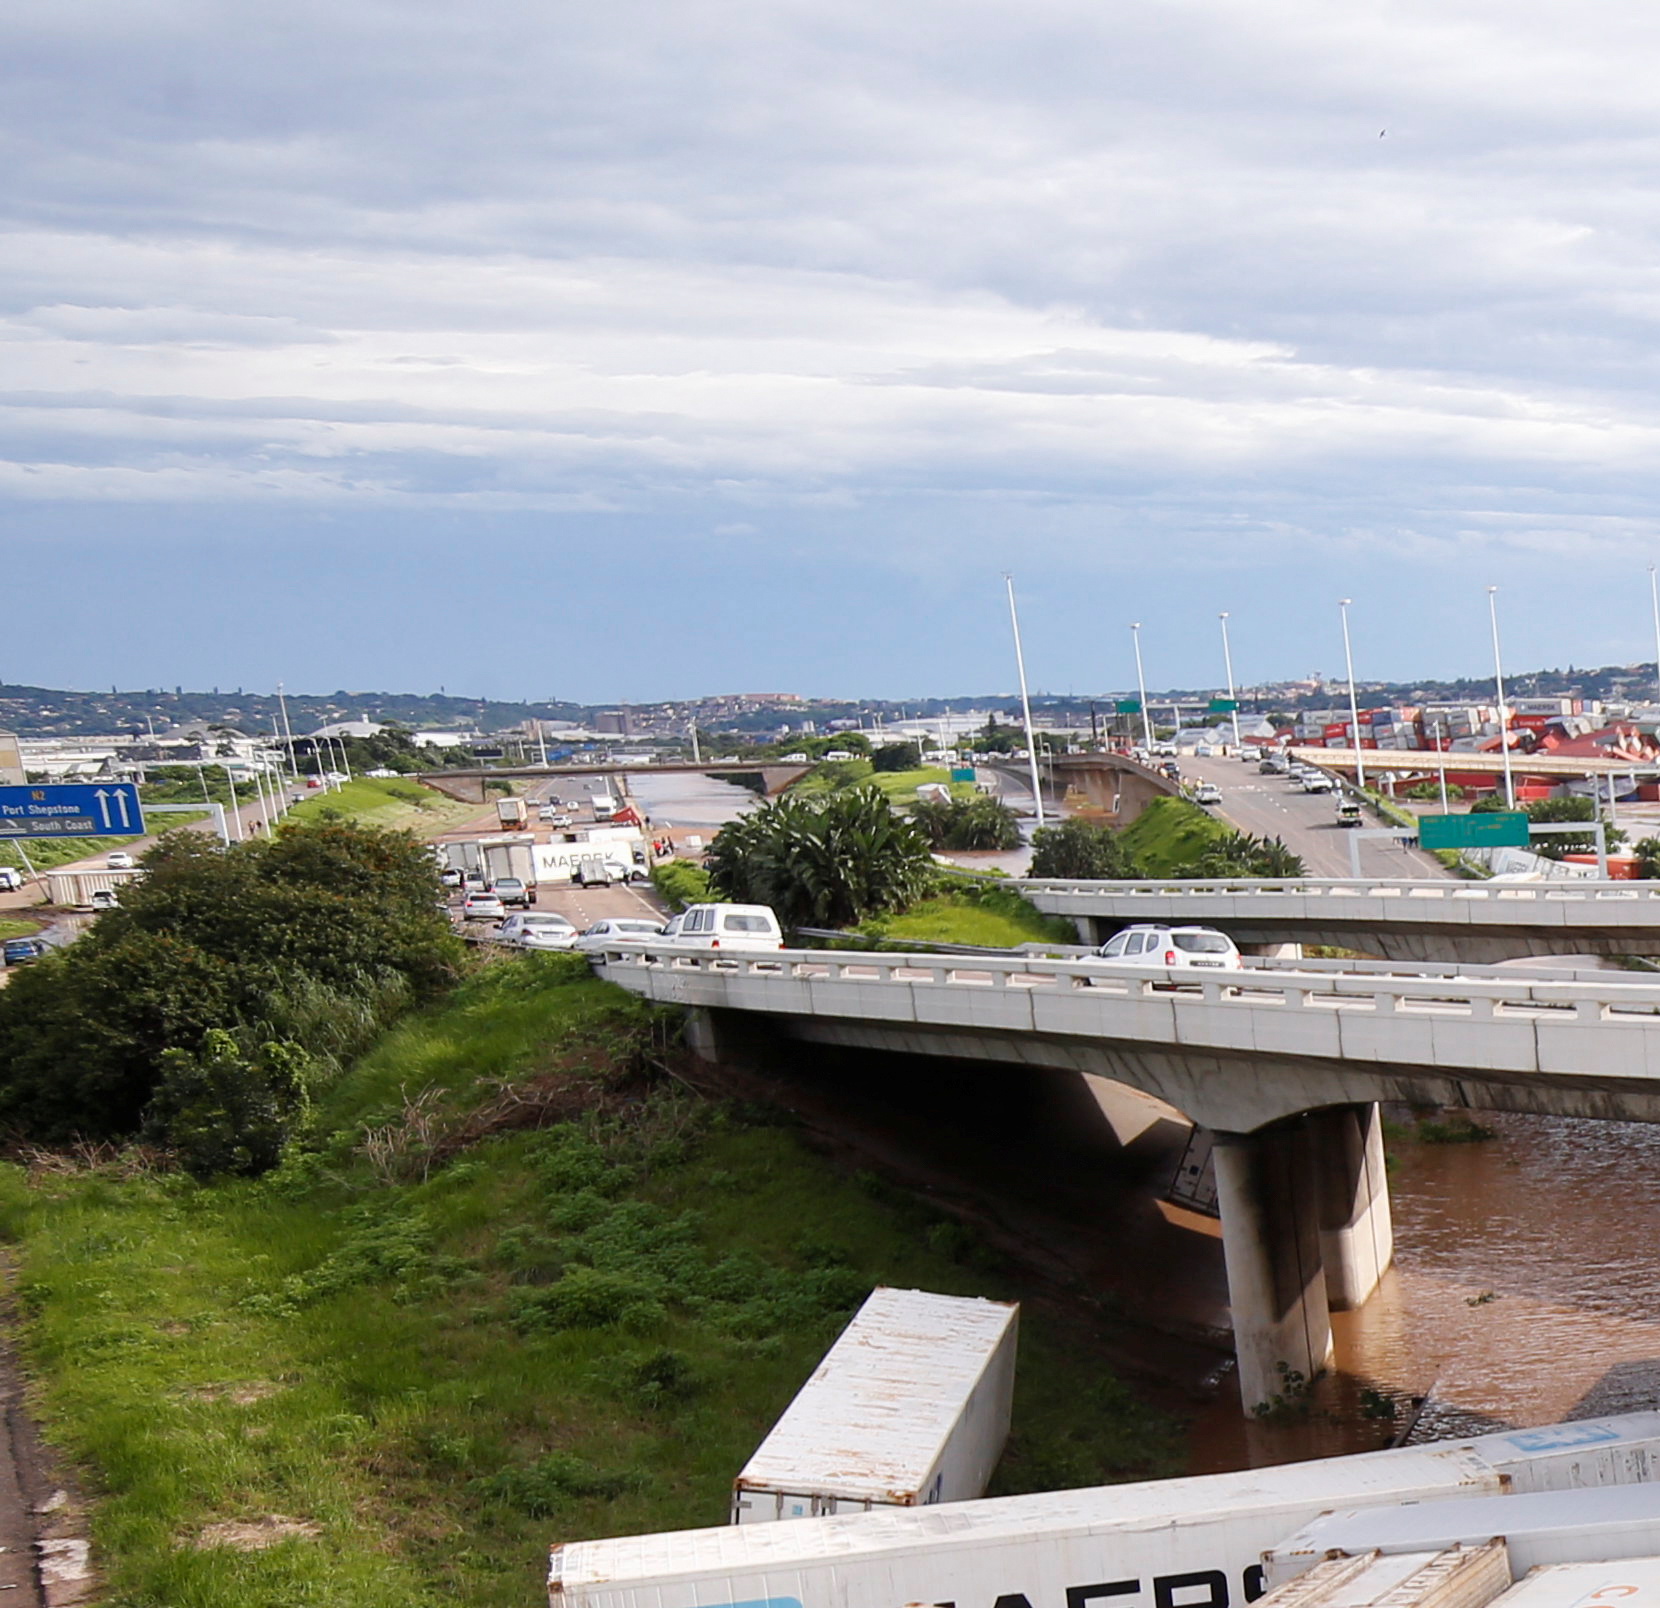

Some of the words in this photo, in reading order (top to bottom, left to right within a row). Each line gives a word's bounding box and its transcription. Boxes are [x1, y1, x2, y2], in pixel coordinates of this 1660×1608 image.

[2, 805, 25, 815] Port
[28, 804, 80, 816] Shepstone
[32, 821, 61, 831] South
[65, 820, 94, 830] Coast
[543, 852, 614, 868] MAERK
